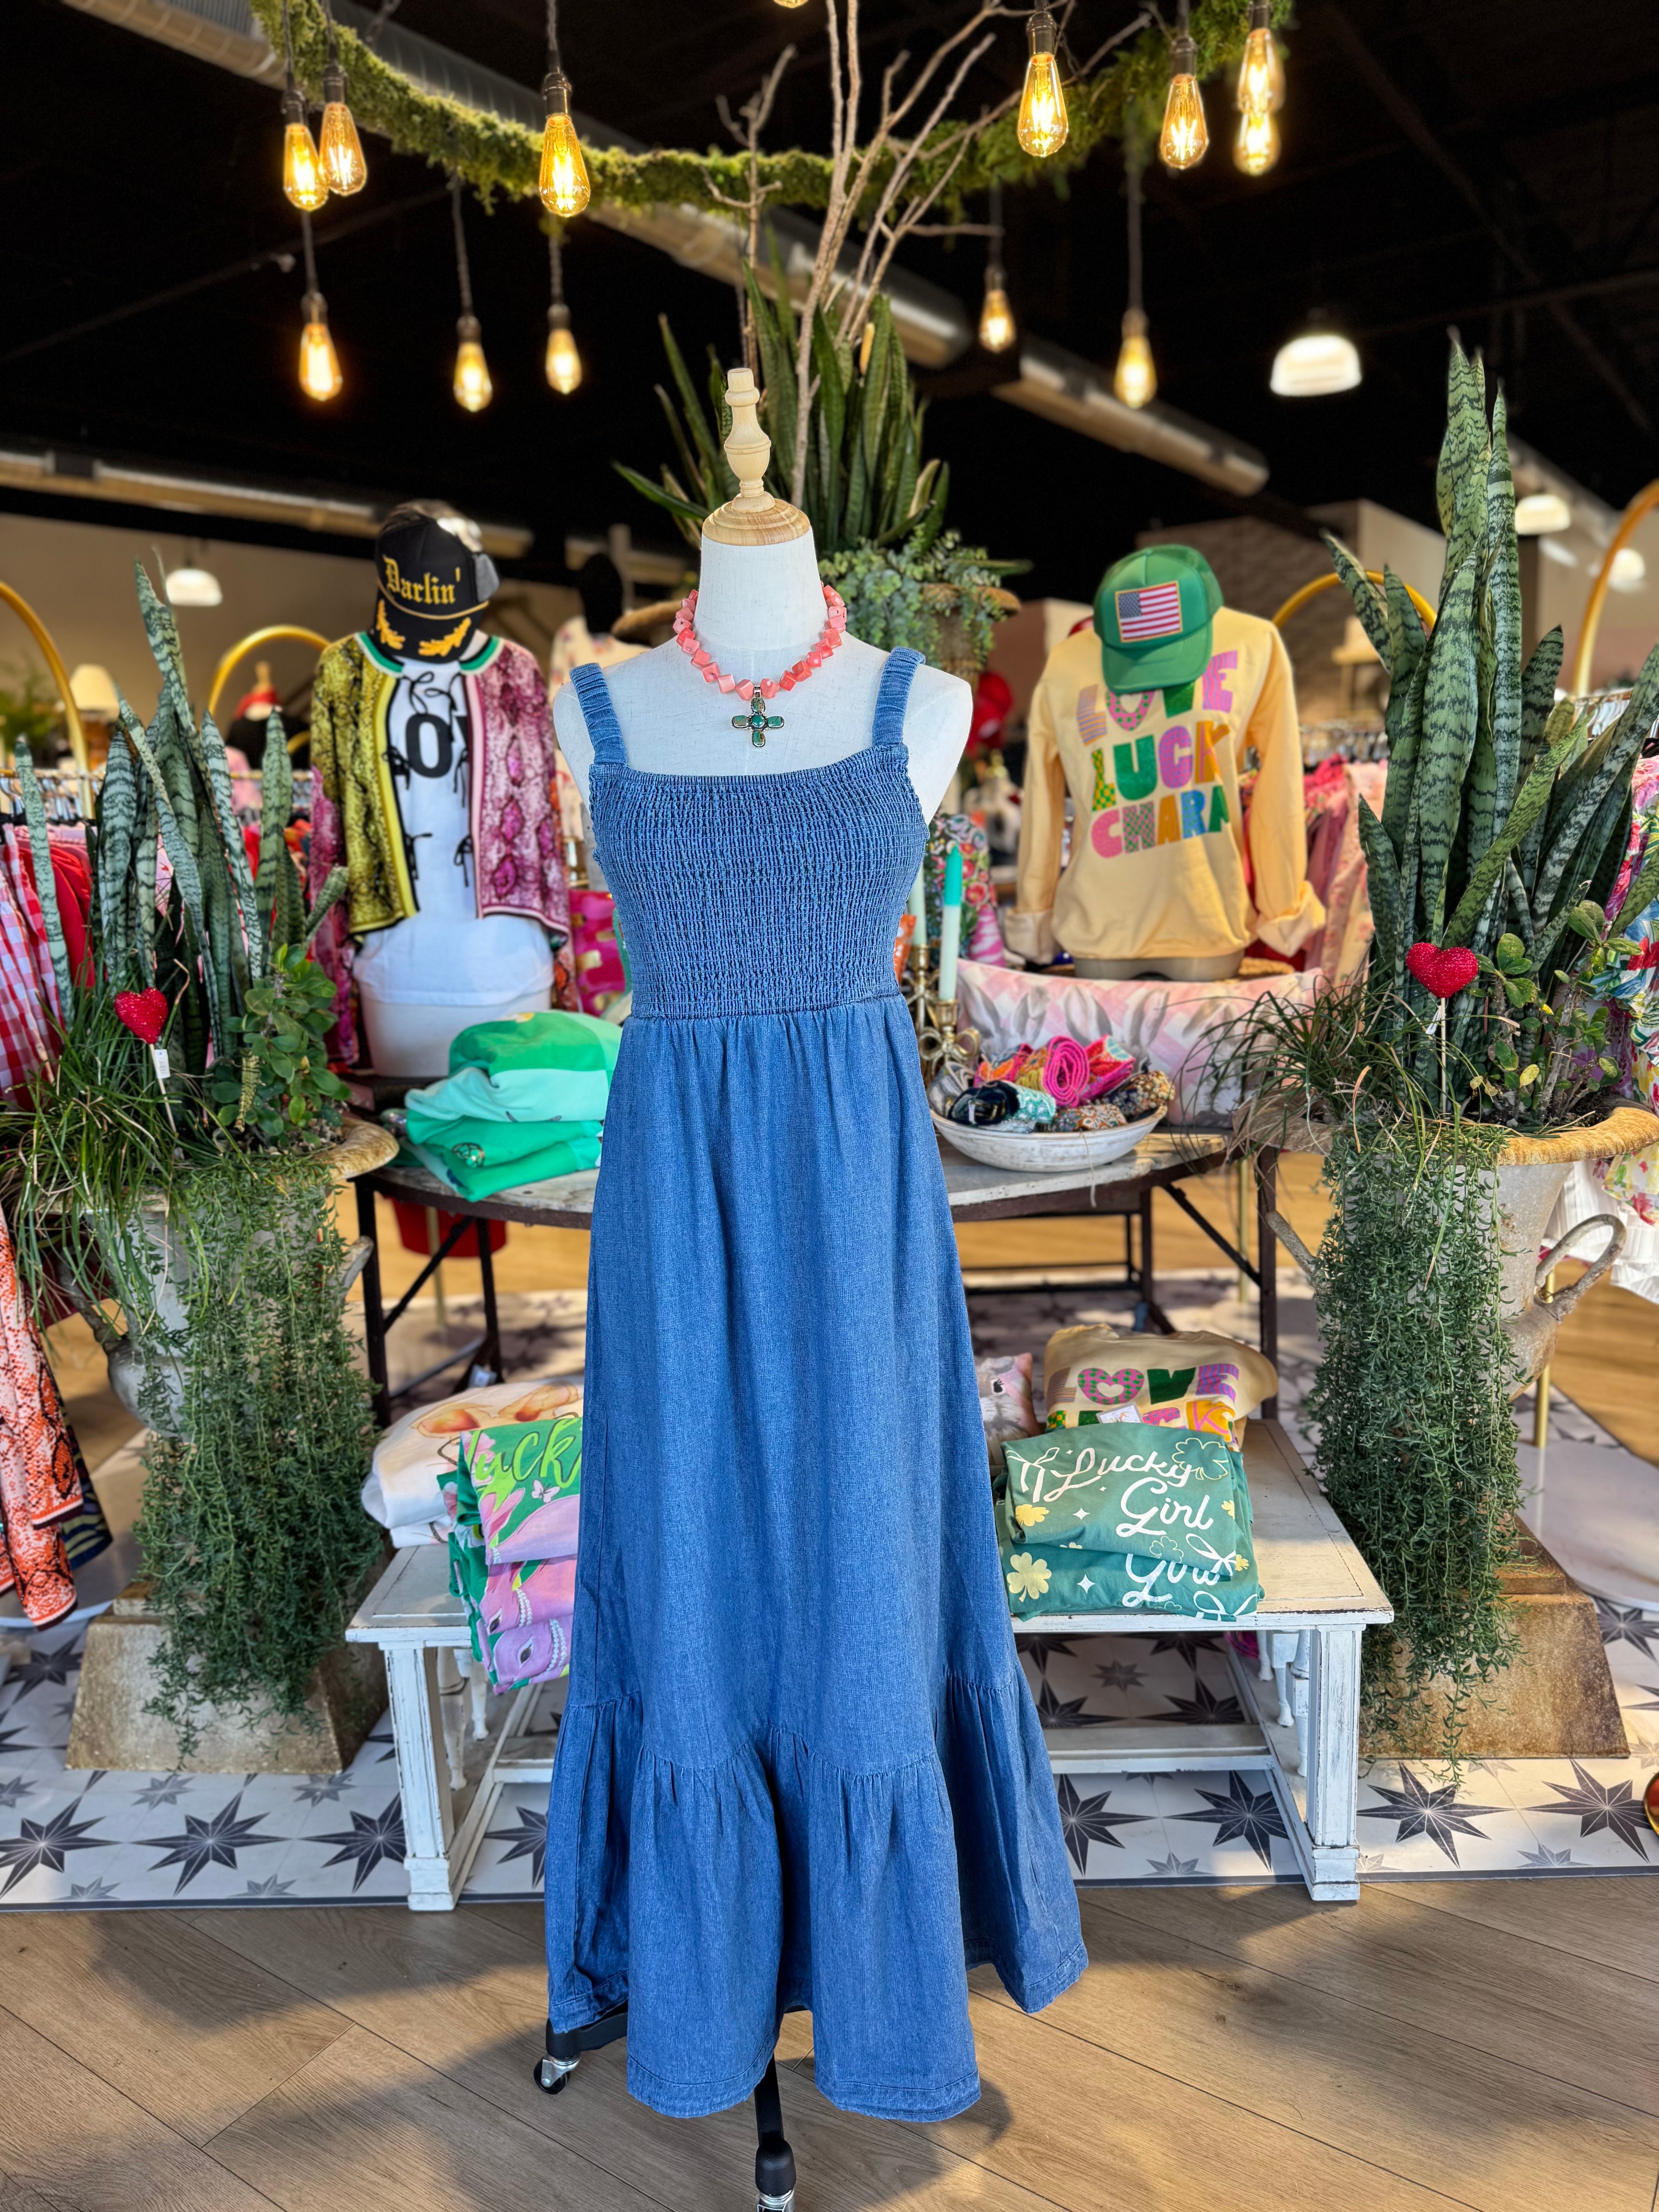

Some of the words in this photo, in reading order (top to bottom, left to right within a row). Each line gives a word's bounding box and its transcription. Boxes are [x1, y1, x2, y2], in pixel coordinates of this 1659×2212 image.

[383, 555, 461, 605] Darlin'
[1091, 721, 1230, 812] LUCK
[1046, 1363, 1239, 1405] LOVE
[1043, 1447, 1192, 1502] Lucky
[1116, 1477, 1214, 1537] Girl
